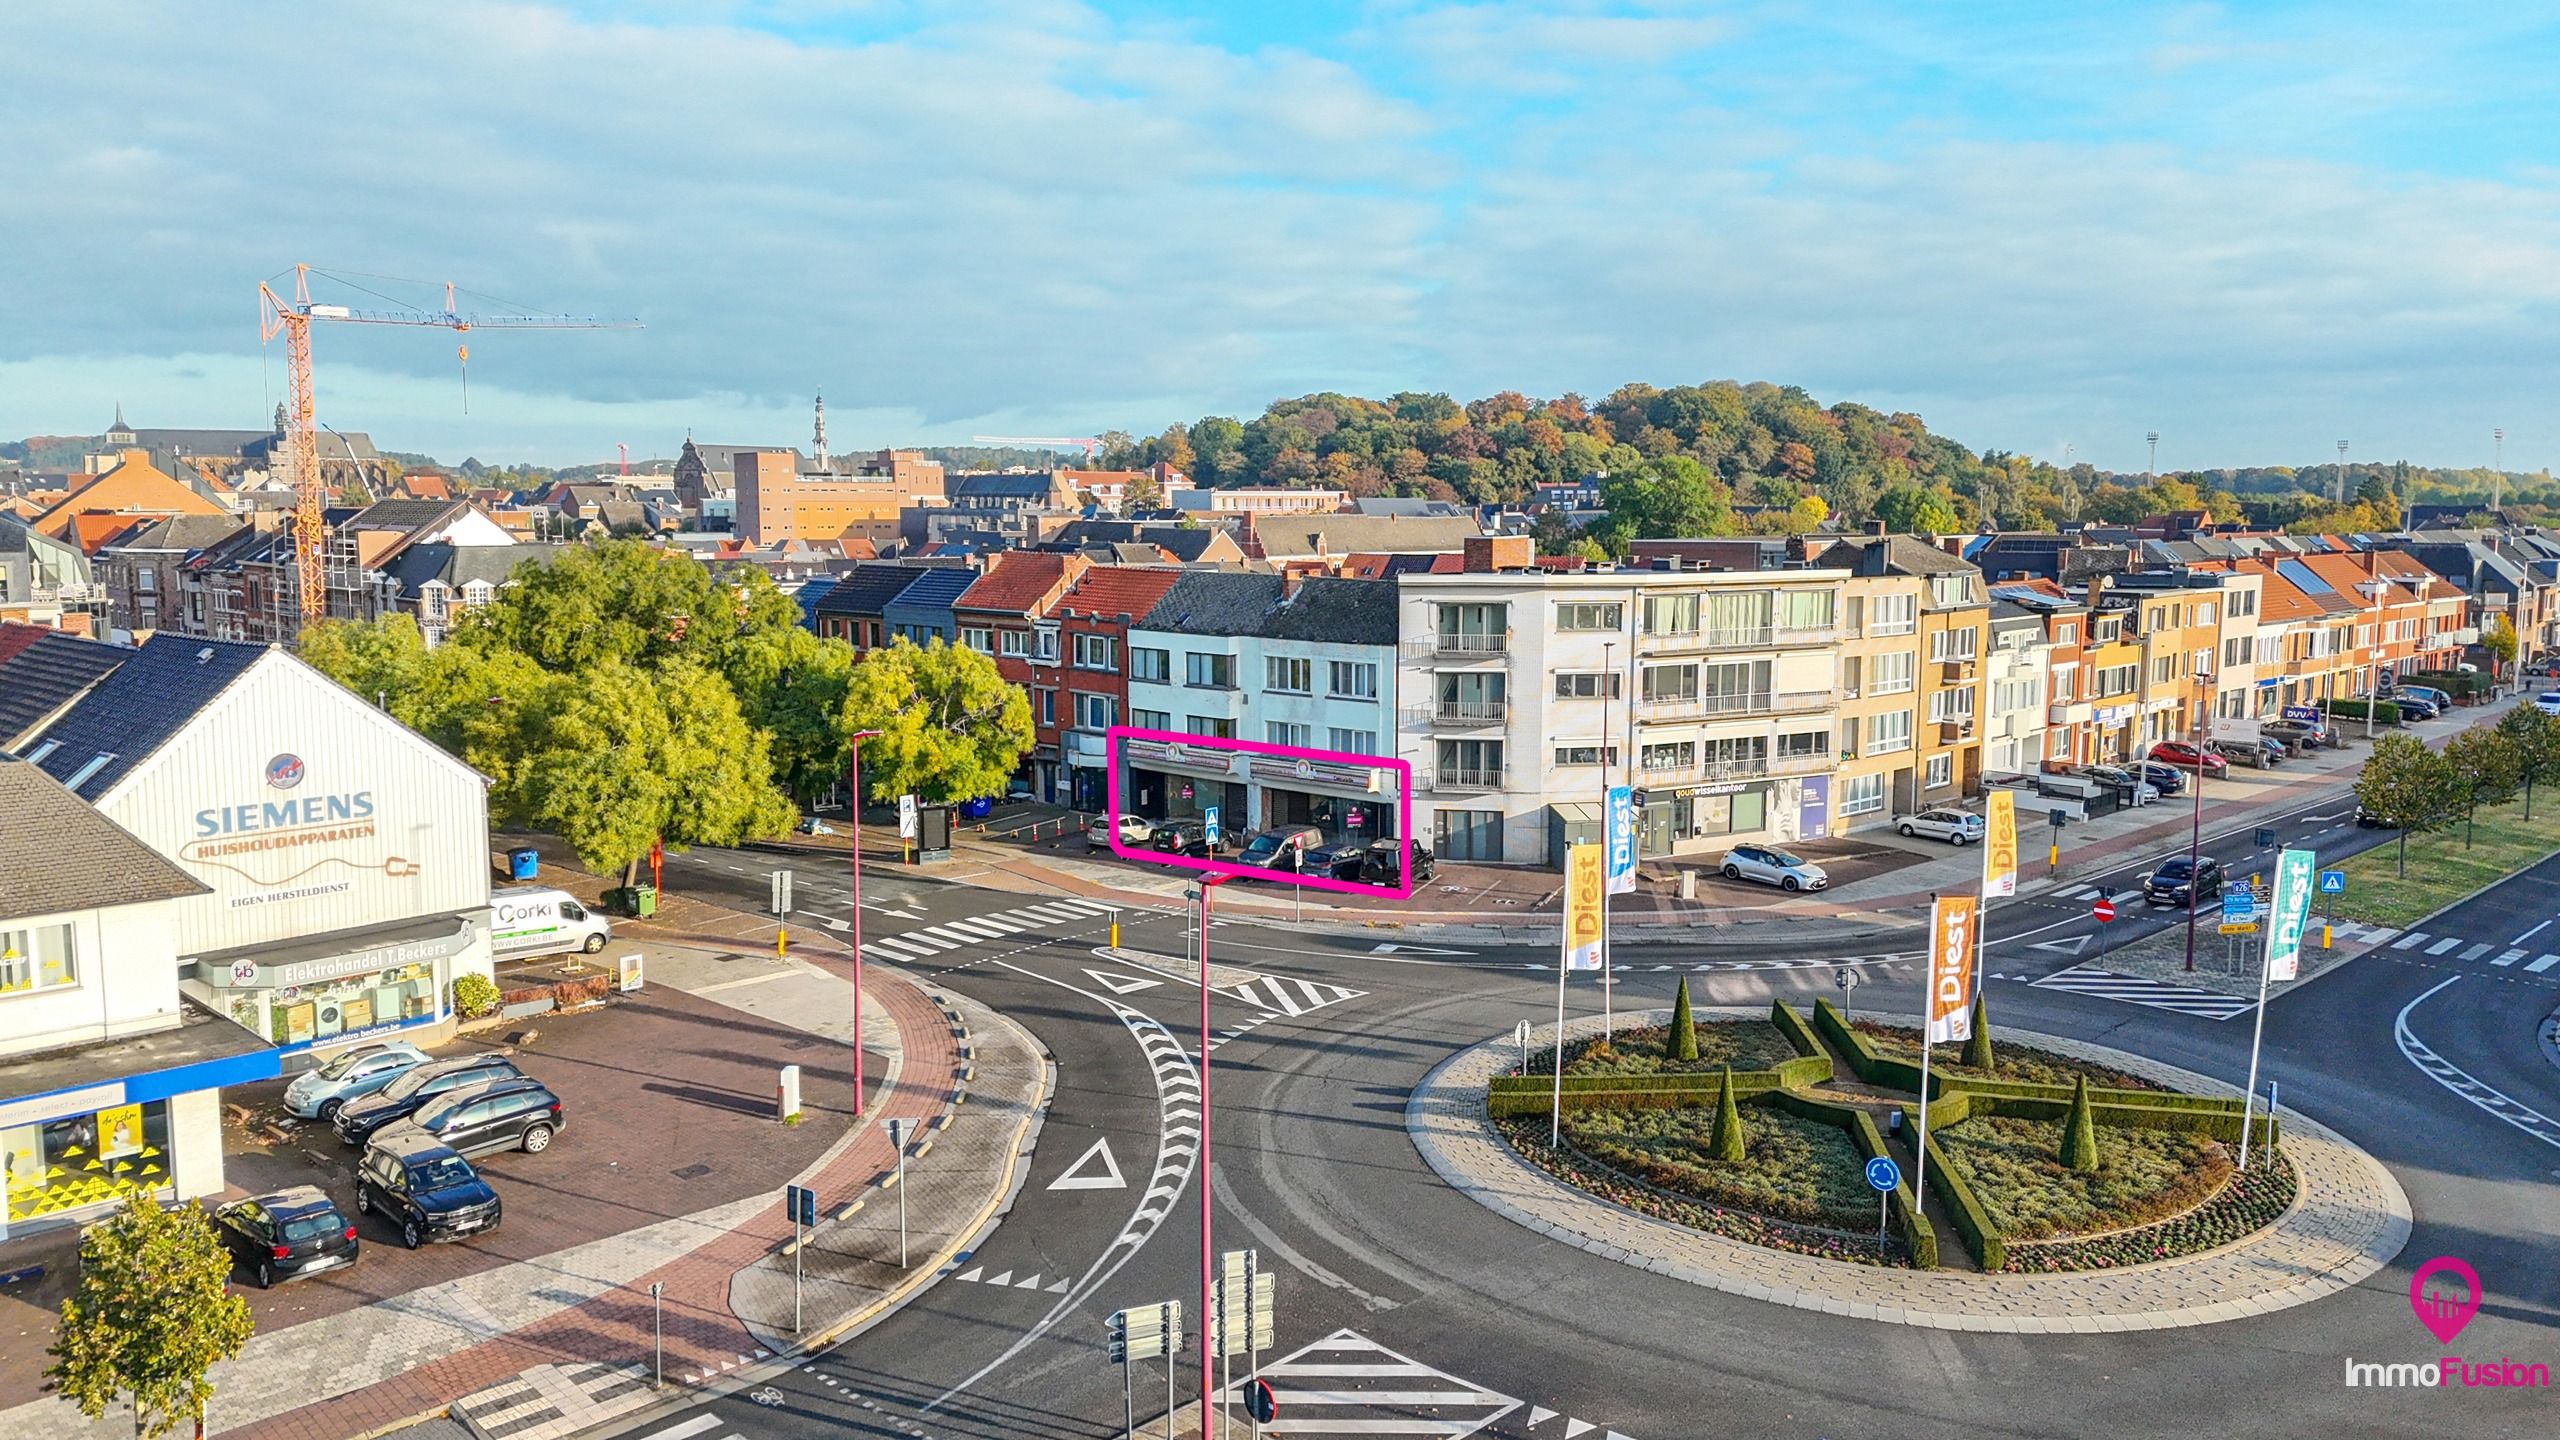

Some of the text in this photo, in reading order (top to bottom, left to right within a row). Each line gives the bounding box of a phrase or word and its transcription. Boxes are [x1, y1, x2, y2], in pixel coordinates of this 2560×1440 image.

[2287, 710, 2306, 718] DVV
[1675, 783, 1747, 799] goudwisselkantoor
[195, 791, 374, 837] SIEMENS
[1612, 793, 1631, 865] Diest
[1993, 801, 2013, 869] Diest
[197, 825, 375, 858] HUISHOUDAPPARATEN
[231, 883, 350, 908] EIGEN HERSTELDIENST
[499, 903, 551, 923] Corki
[1574, 856, 1598, 936] Diest
[2279, 862, 2309, 944] Diest
[285, 941, 447, 982] Elektrohandel T.Beckers
[1939, 911, 1967, 1003] Diest
